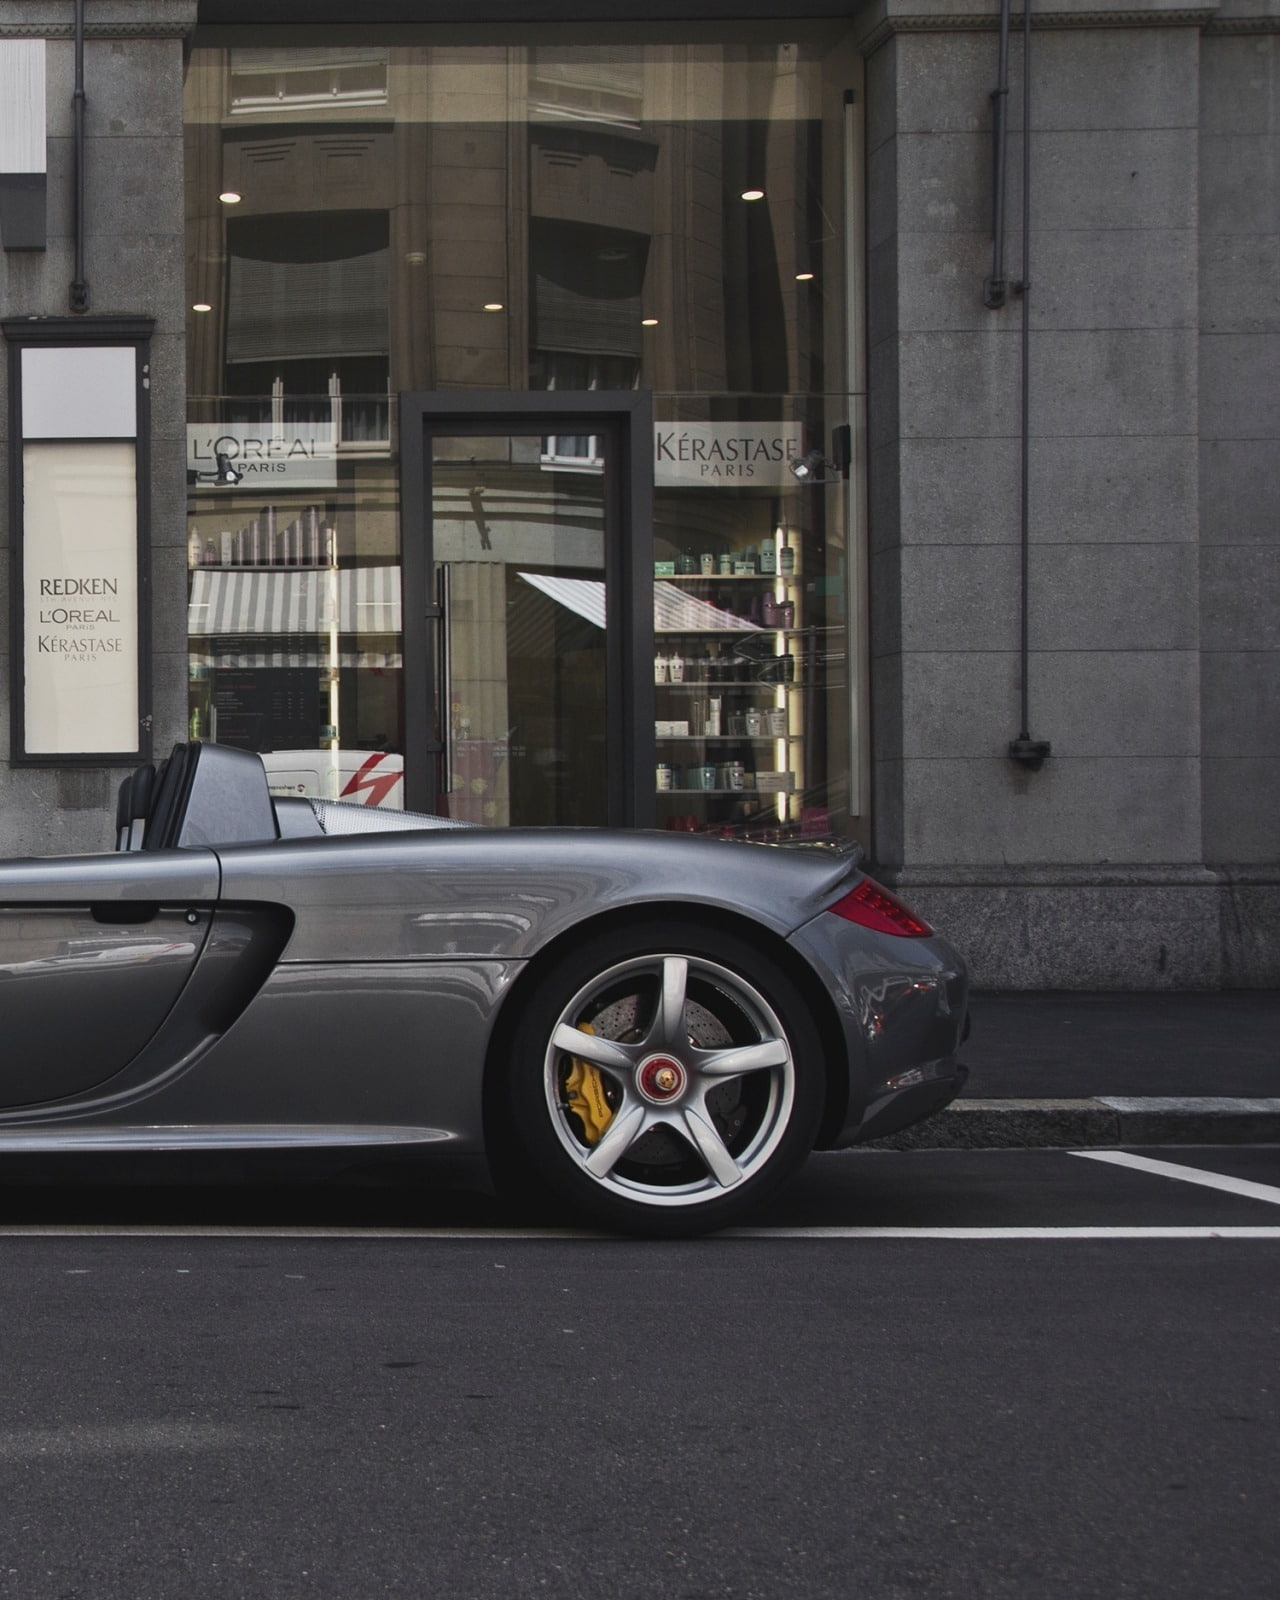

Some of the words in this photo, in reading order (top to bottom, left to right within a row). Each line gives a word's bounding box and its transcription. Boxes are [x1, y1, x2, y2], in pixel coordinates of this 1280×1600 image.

[657, 432, 798, 462] KÉRASTASE
[700, 464, 755, 477] PARIS
[39, 578, 118, 596] REDKEN
[38, 634, 123, 653] KÉRASTASE
[64, 654, 97, 662] PARIS
